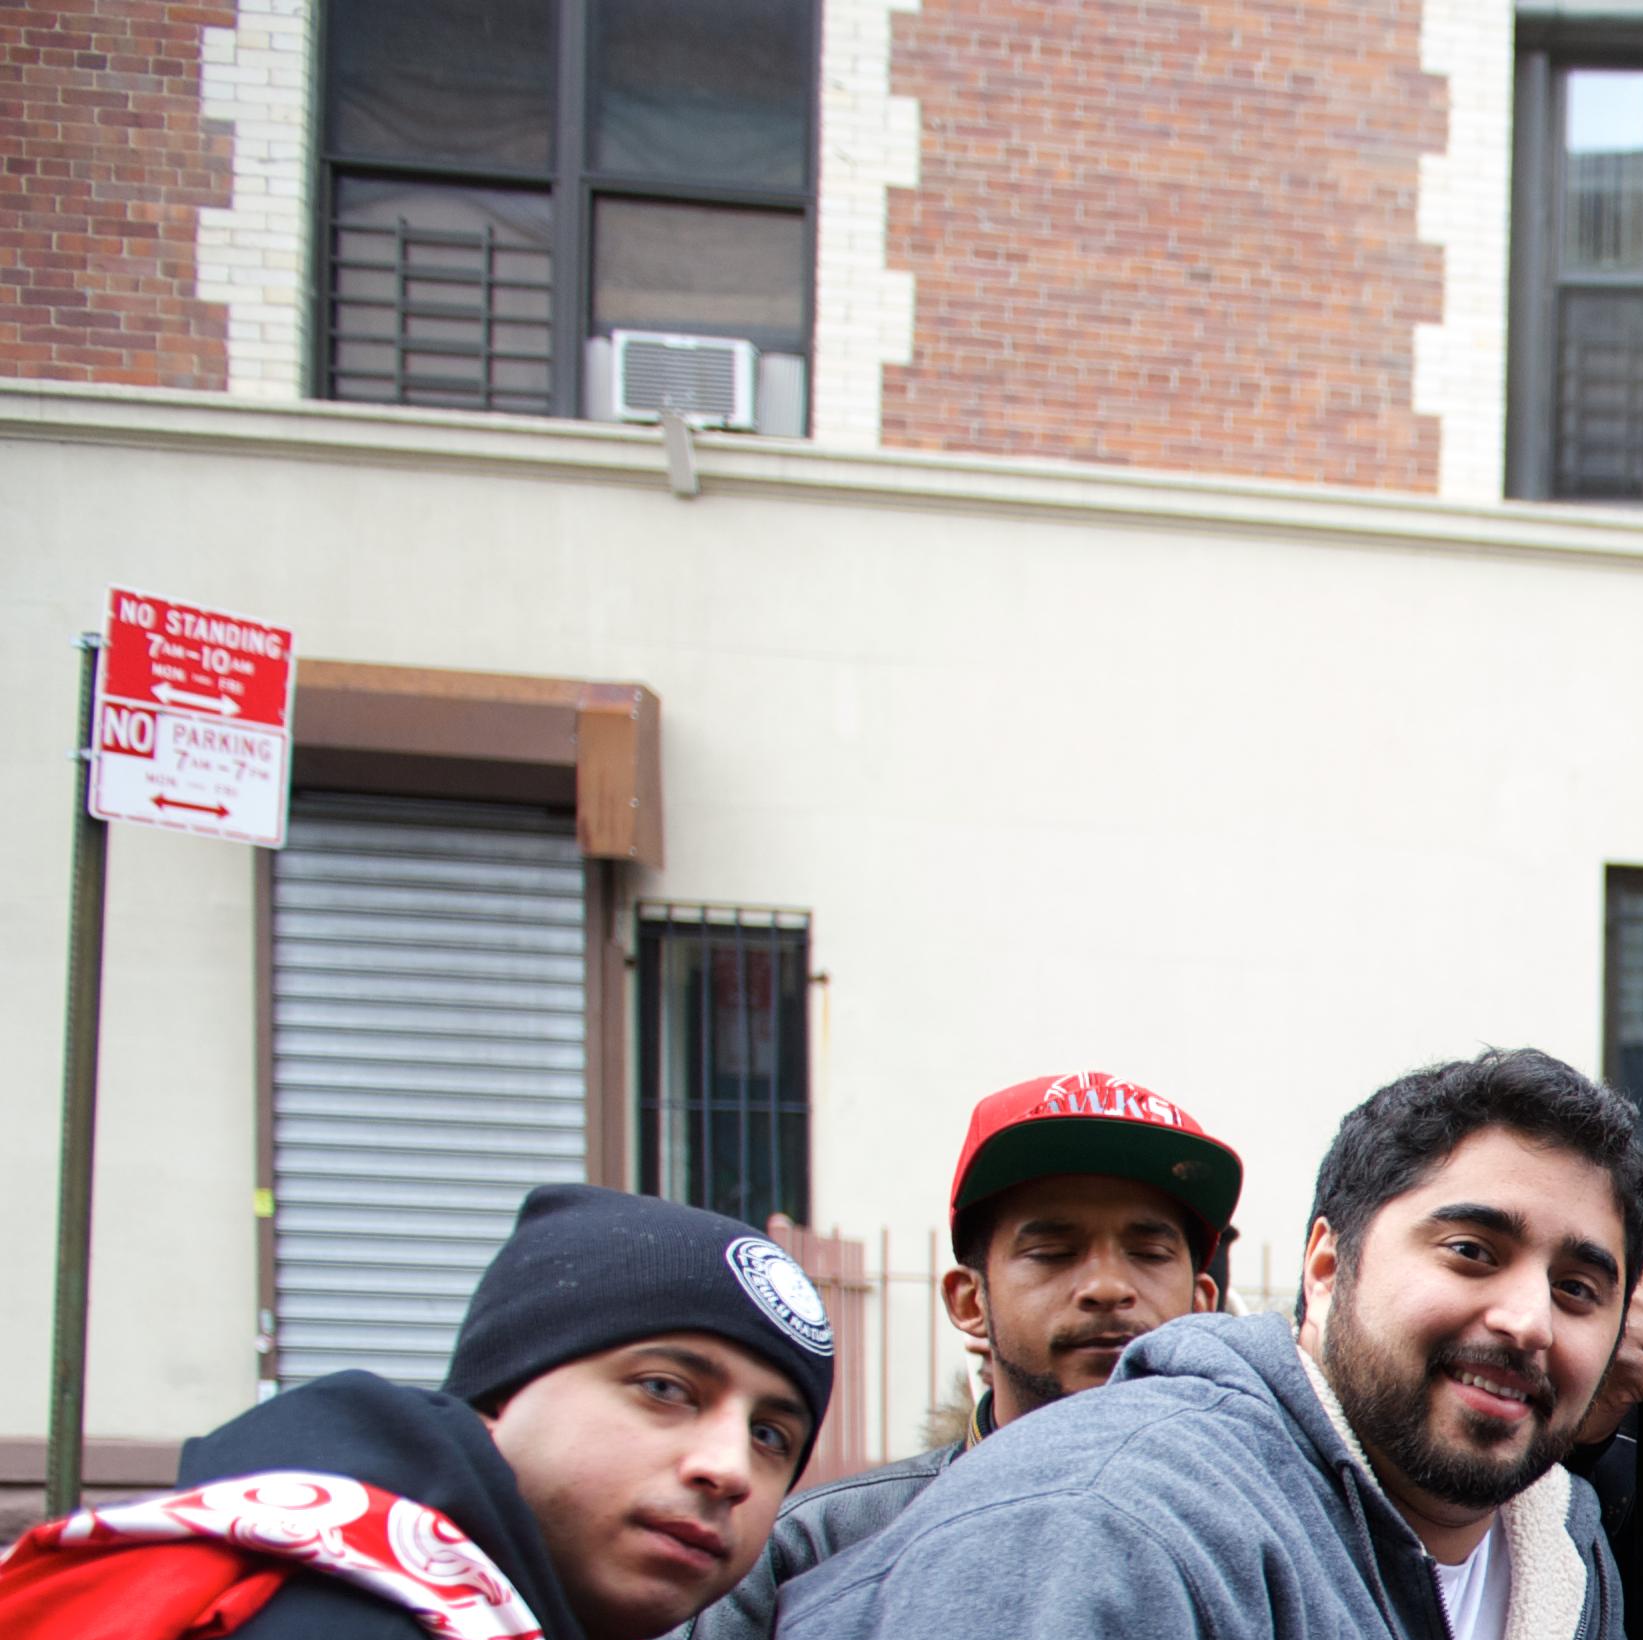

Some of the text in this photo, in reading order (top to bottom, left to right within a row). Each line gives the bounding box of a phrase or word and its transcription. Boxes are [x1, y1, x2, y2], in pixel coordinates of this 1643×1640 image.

[120, 598, 283, 660] NO STANDING
[103, 708, 273, 763] NO PARKING
